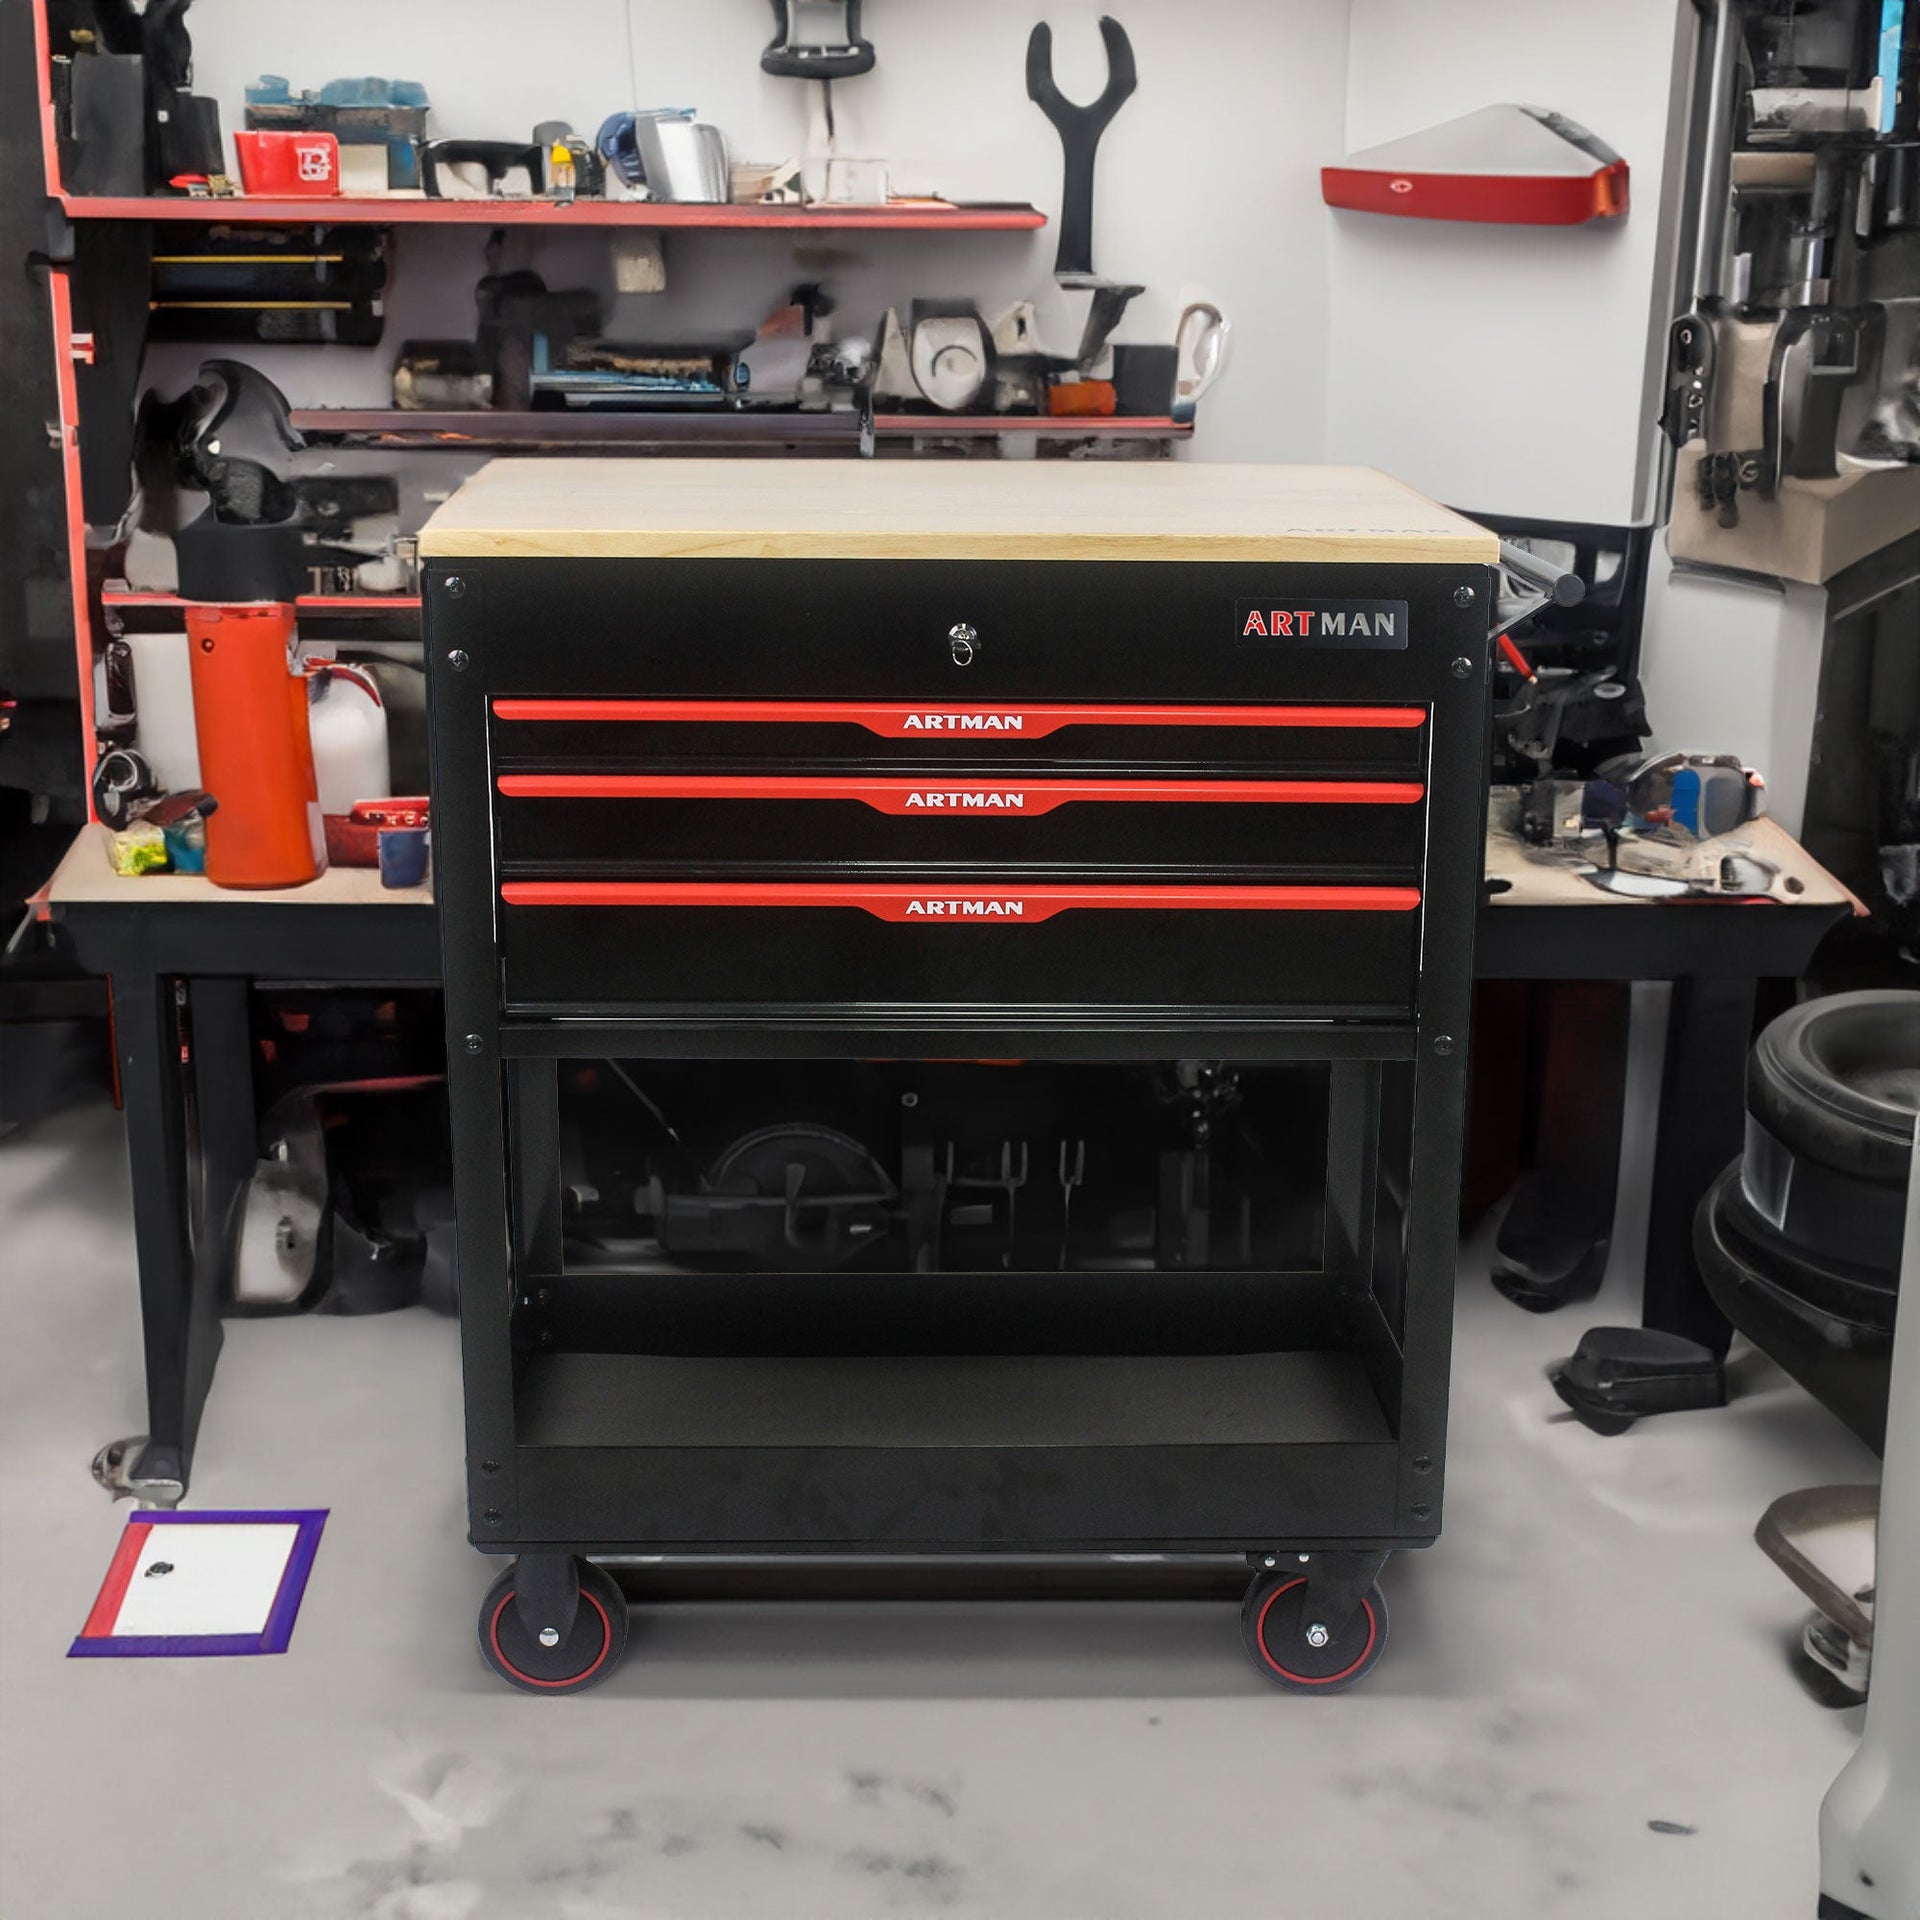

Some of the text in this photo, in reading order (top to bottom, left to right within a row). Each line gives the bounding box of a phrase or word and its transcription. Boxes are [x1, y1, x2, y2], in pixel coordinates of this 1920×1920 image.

[1243, 610, 1395, 635] ARTMAN
[903, 715, 1022, 729] ARTMAN
[905, 793, 1023, 807] ARTMAN
[905, 901, 1022, 914] ARTMAN
